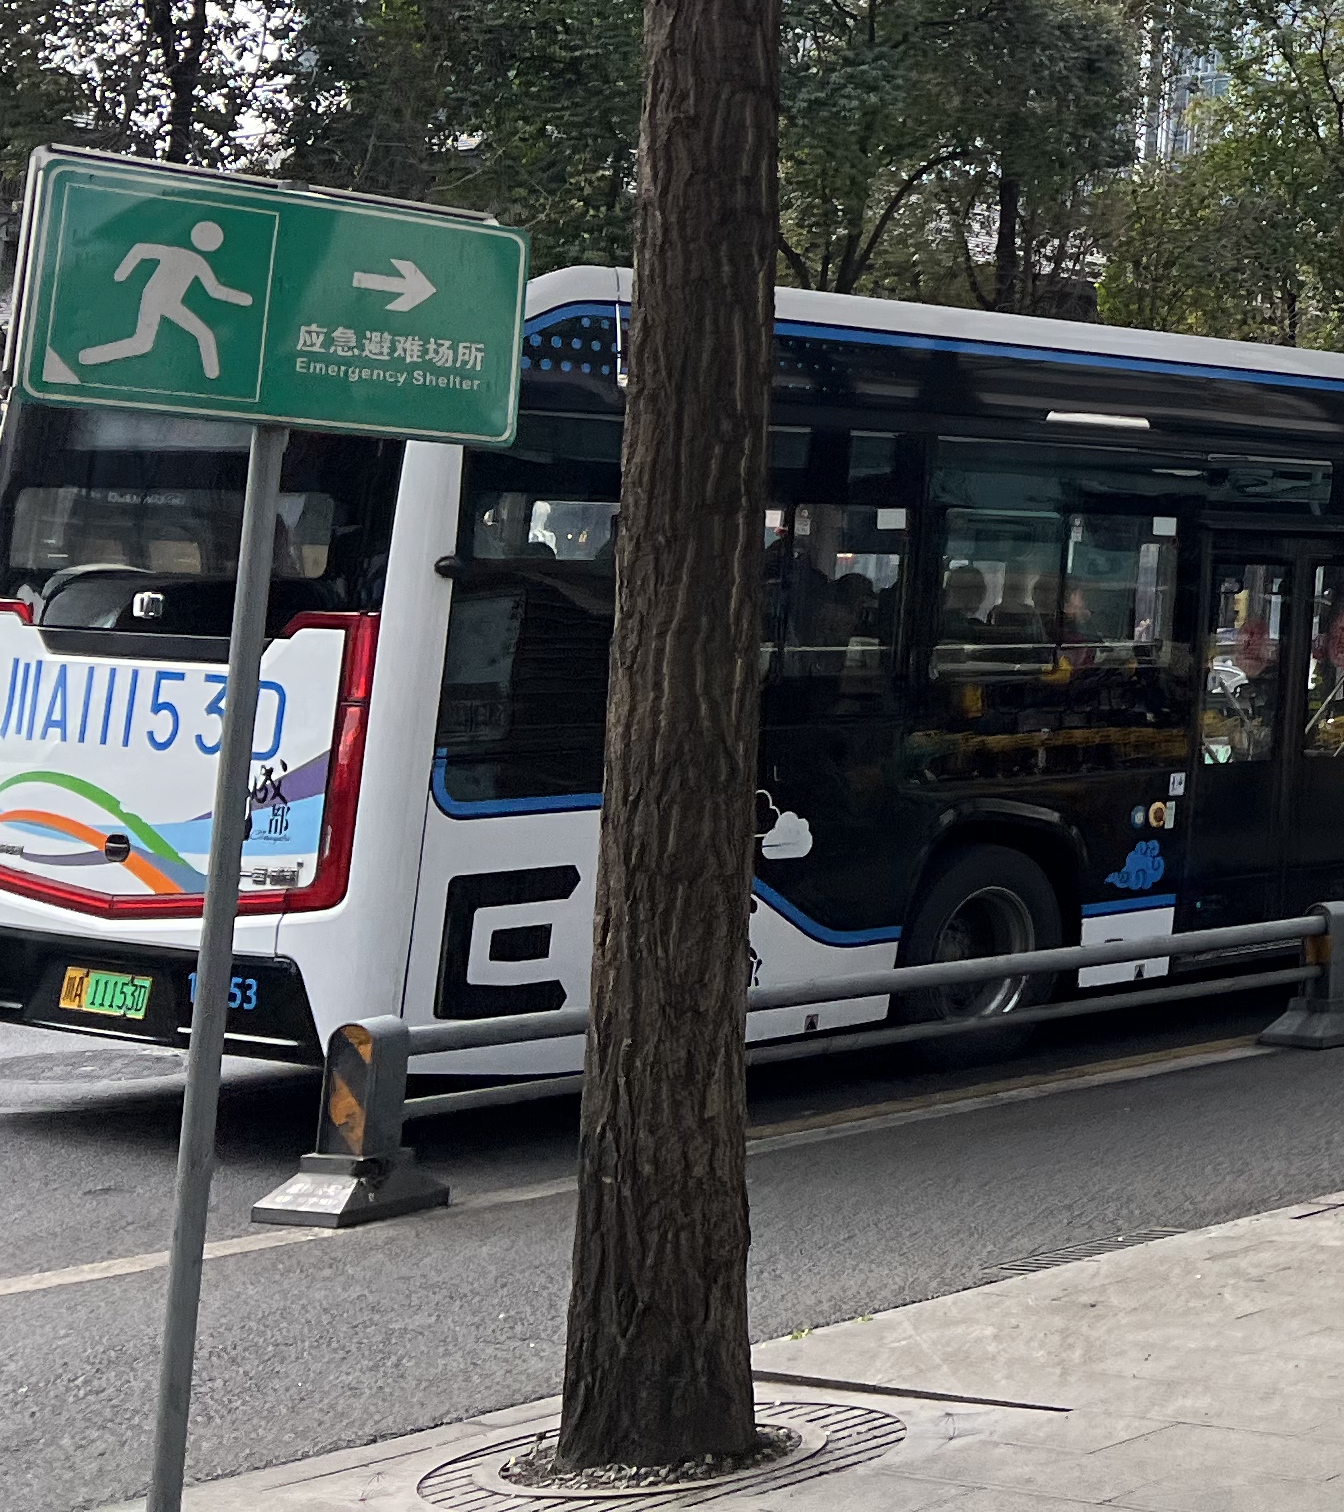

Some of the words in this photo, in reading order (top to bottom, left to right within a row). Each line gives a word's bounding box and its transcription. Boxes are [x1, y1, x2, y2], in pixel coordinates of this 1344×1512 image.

[296, 323, 485, 371] 应急避难场所
[295, 357, 407, 387] Emergency
[412, 370, 481, 390] Shelter
[187, 972, 258, 1010] 153
